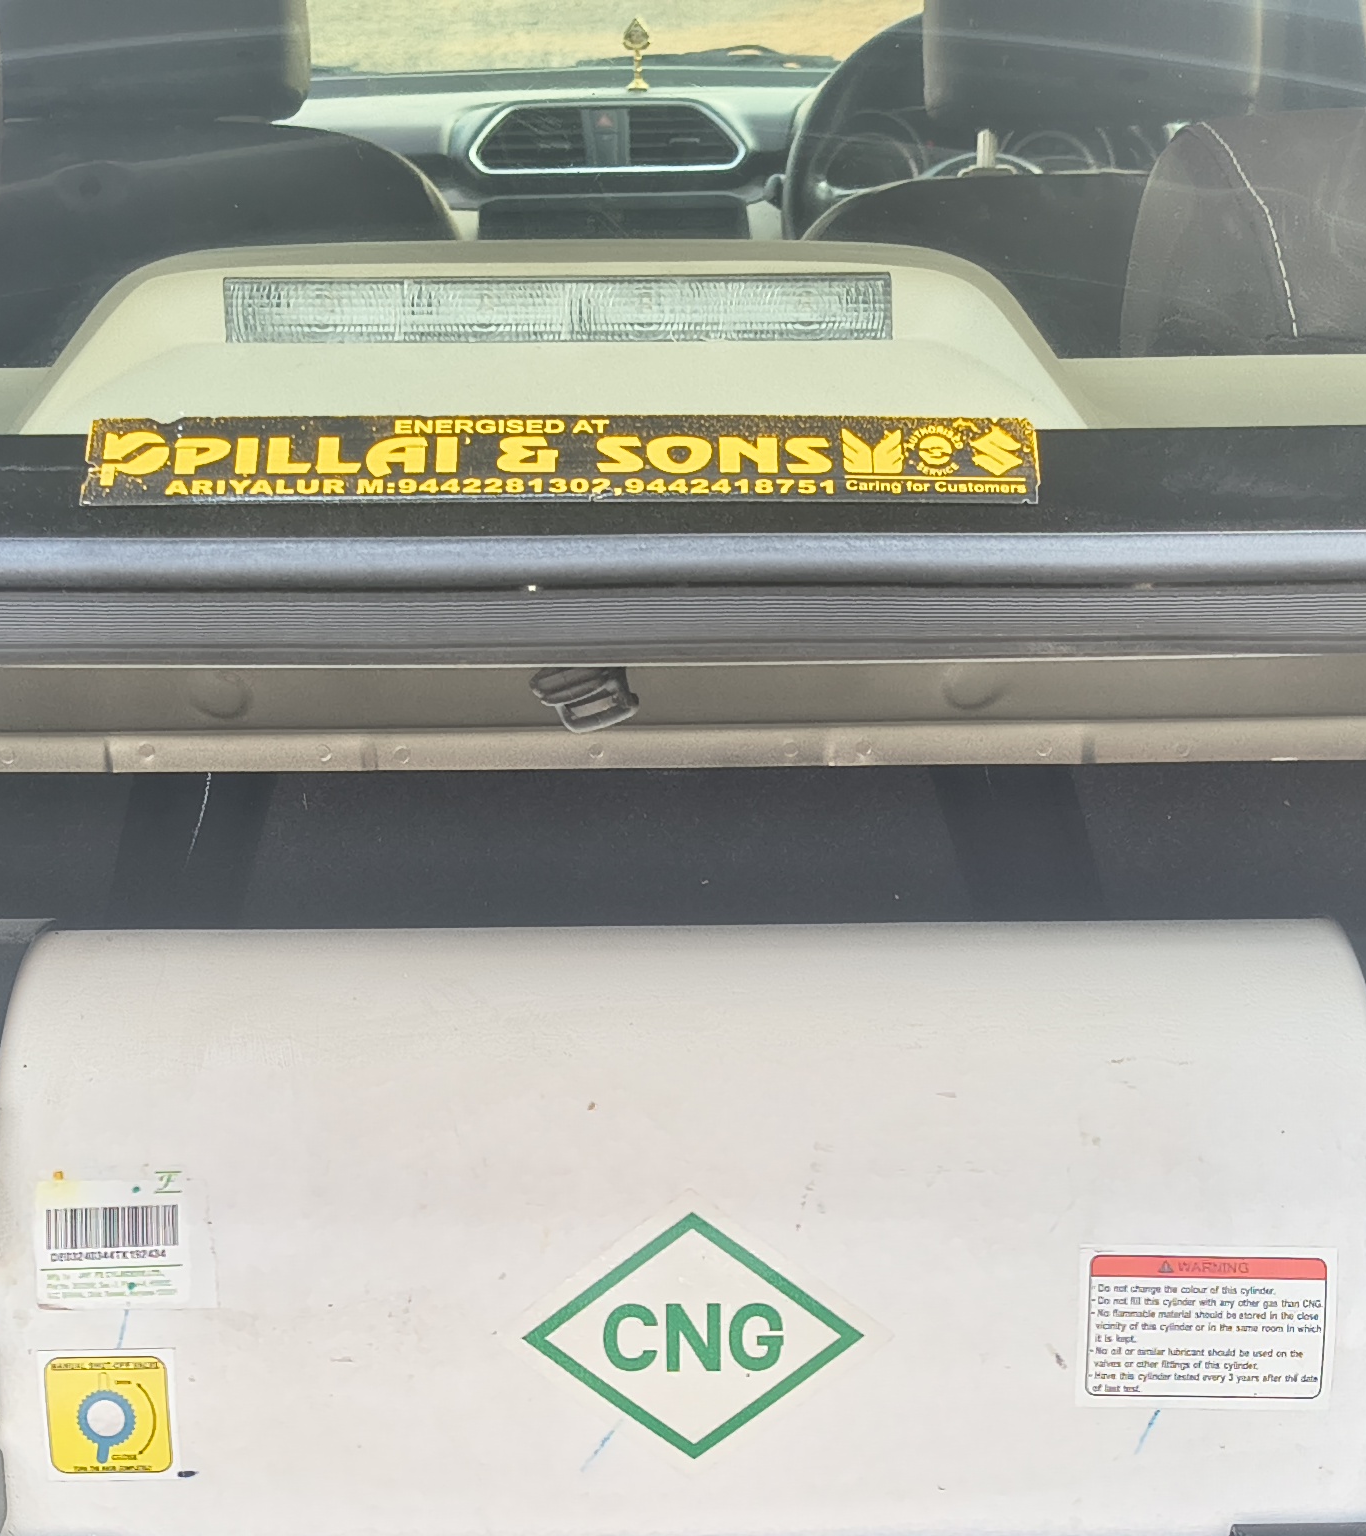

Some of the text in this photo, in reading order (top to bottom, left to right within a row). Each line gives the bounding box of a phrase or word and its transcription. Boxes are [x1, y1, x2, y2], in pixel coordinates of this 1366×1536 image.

[395, 419, 610, 434] ENERGISED AT
[174, 436, 458, 477] PILLAI
[496, 436, 559, 473] &
[596, 436, 833, 474] SONS
[165, 479, 346, 495] ARIYALUR
[845, 480, 1028, 494] Caring for Customers
[1178, 1261, 1249, 1273] WARNING
[602, 1303, 784, 1372] CNG
